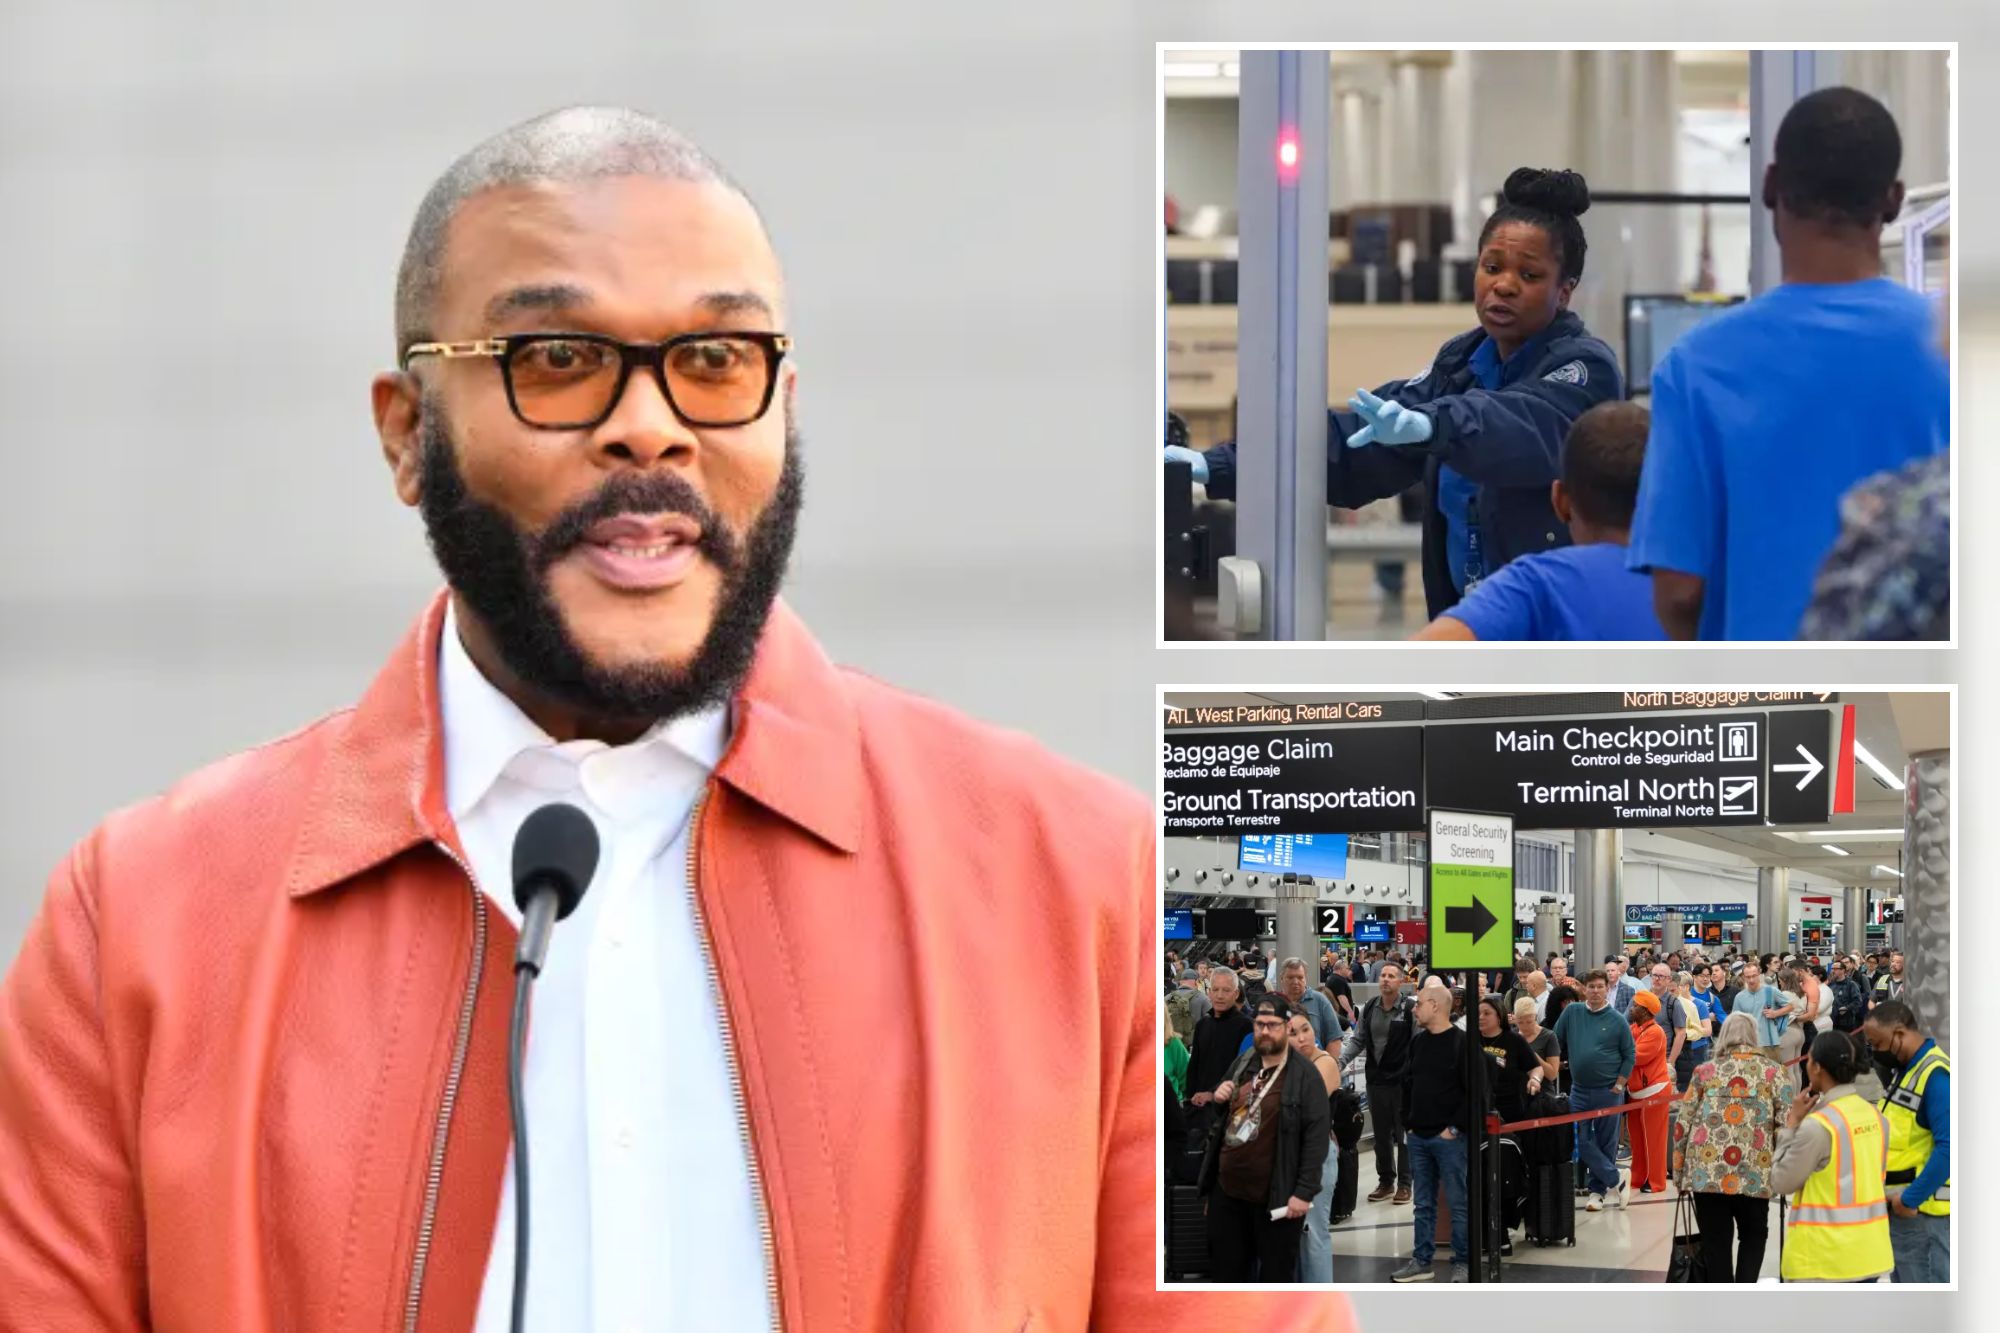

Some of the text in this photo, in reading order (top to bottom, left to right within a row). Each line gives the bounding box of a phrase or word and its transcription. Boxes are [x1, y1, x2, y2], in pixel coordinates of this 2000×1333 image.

[1623, 692, 1667, 707] North
[1672, 692, 1749, 707] Baggage
[1167, 702, 1382, 725] ATL West Parking, Rental Cars
[1495, 724, 1714, 752] Main Checkpoint
[1163, 738, 1333, 766] Baggage Claim
[1571, 750, 1714, 767] Control de Seguridad
[1211, 765, 1227, 777] de
[1229, 764, 1281, 778] Equipaje
[1163, 785, 1416, 813] Ground Transportation
[1517, 777, 1714, 804] Terminal North
[1613, 803, 1714, 818] Terminal Norte
[1163, 814, 1281, 828] Transporte Terrestre
[1436, 821, 1508, 843] General Security
[1450, 844, 1494, 862] Screening
[1322, 908, 1340, 933] 2
[1397, 933, 1404, 943] 3
[1686, 925, 1697, 938] 4
